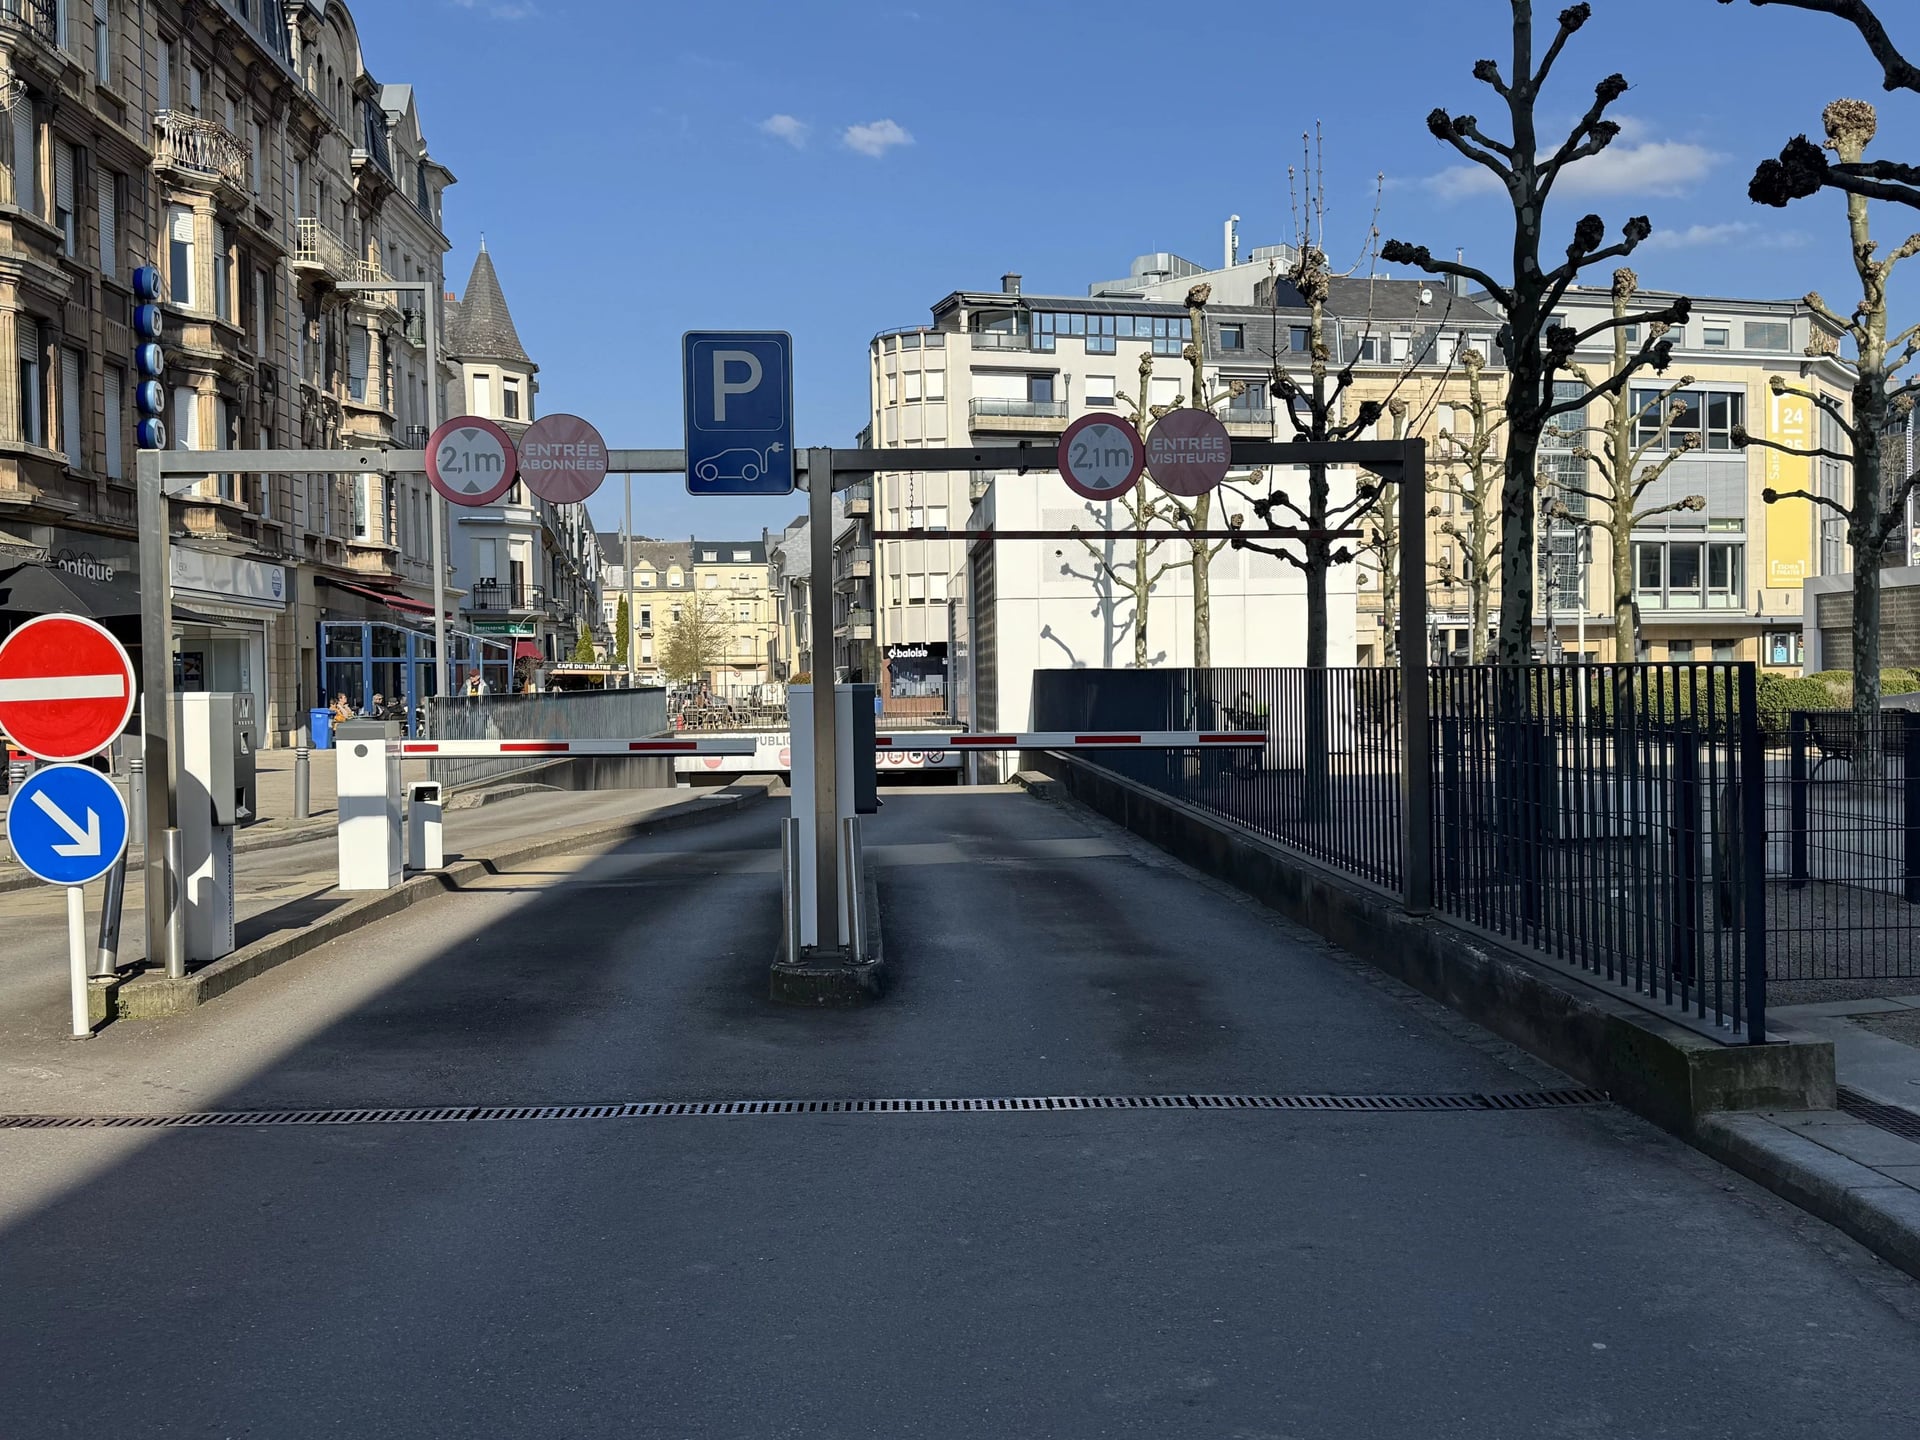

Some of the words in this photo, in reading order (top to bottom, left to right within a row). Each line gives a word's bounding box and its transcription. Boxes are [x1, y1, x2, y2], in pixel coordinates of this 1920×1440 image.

[712, 349, 763, 422] P
[1783, 406, 1804, 425] 24
[525, 440, 600, 457] ENTRÉE
[1152, 433, 1224, 451] ENTRÉE
[520, 457, 605, 471] ABONNÉES
[1150, 452, 1226, 465] VISITEURS
[58, 558, 114, 582] optique
[896, 646, 929, 658] baloise
[557, 661, 573, 670] CAFÉ
[584, 662, 612, 671] THÉÂTRE
